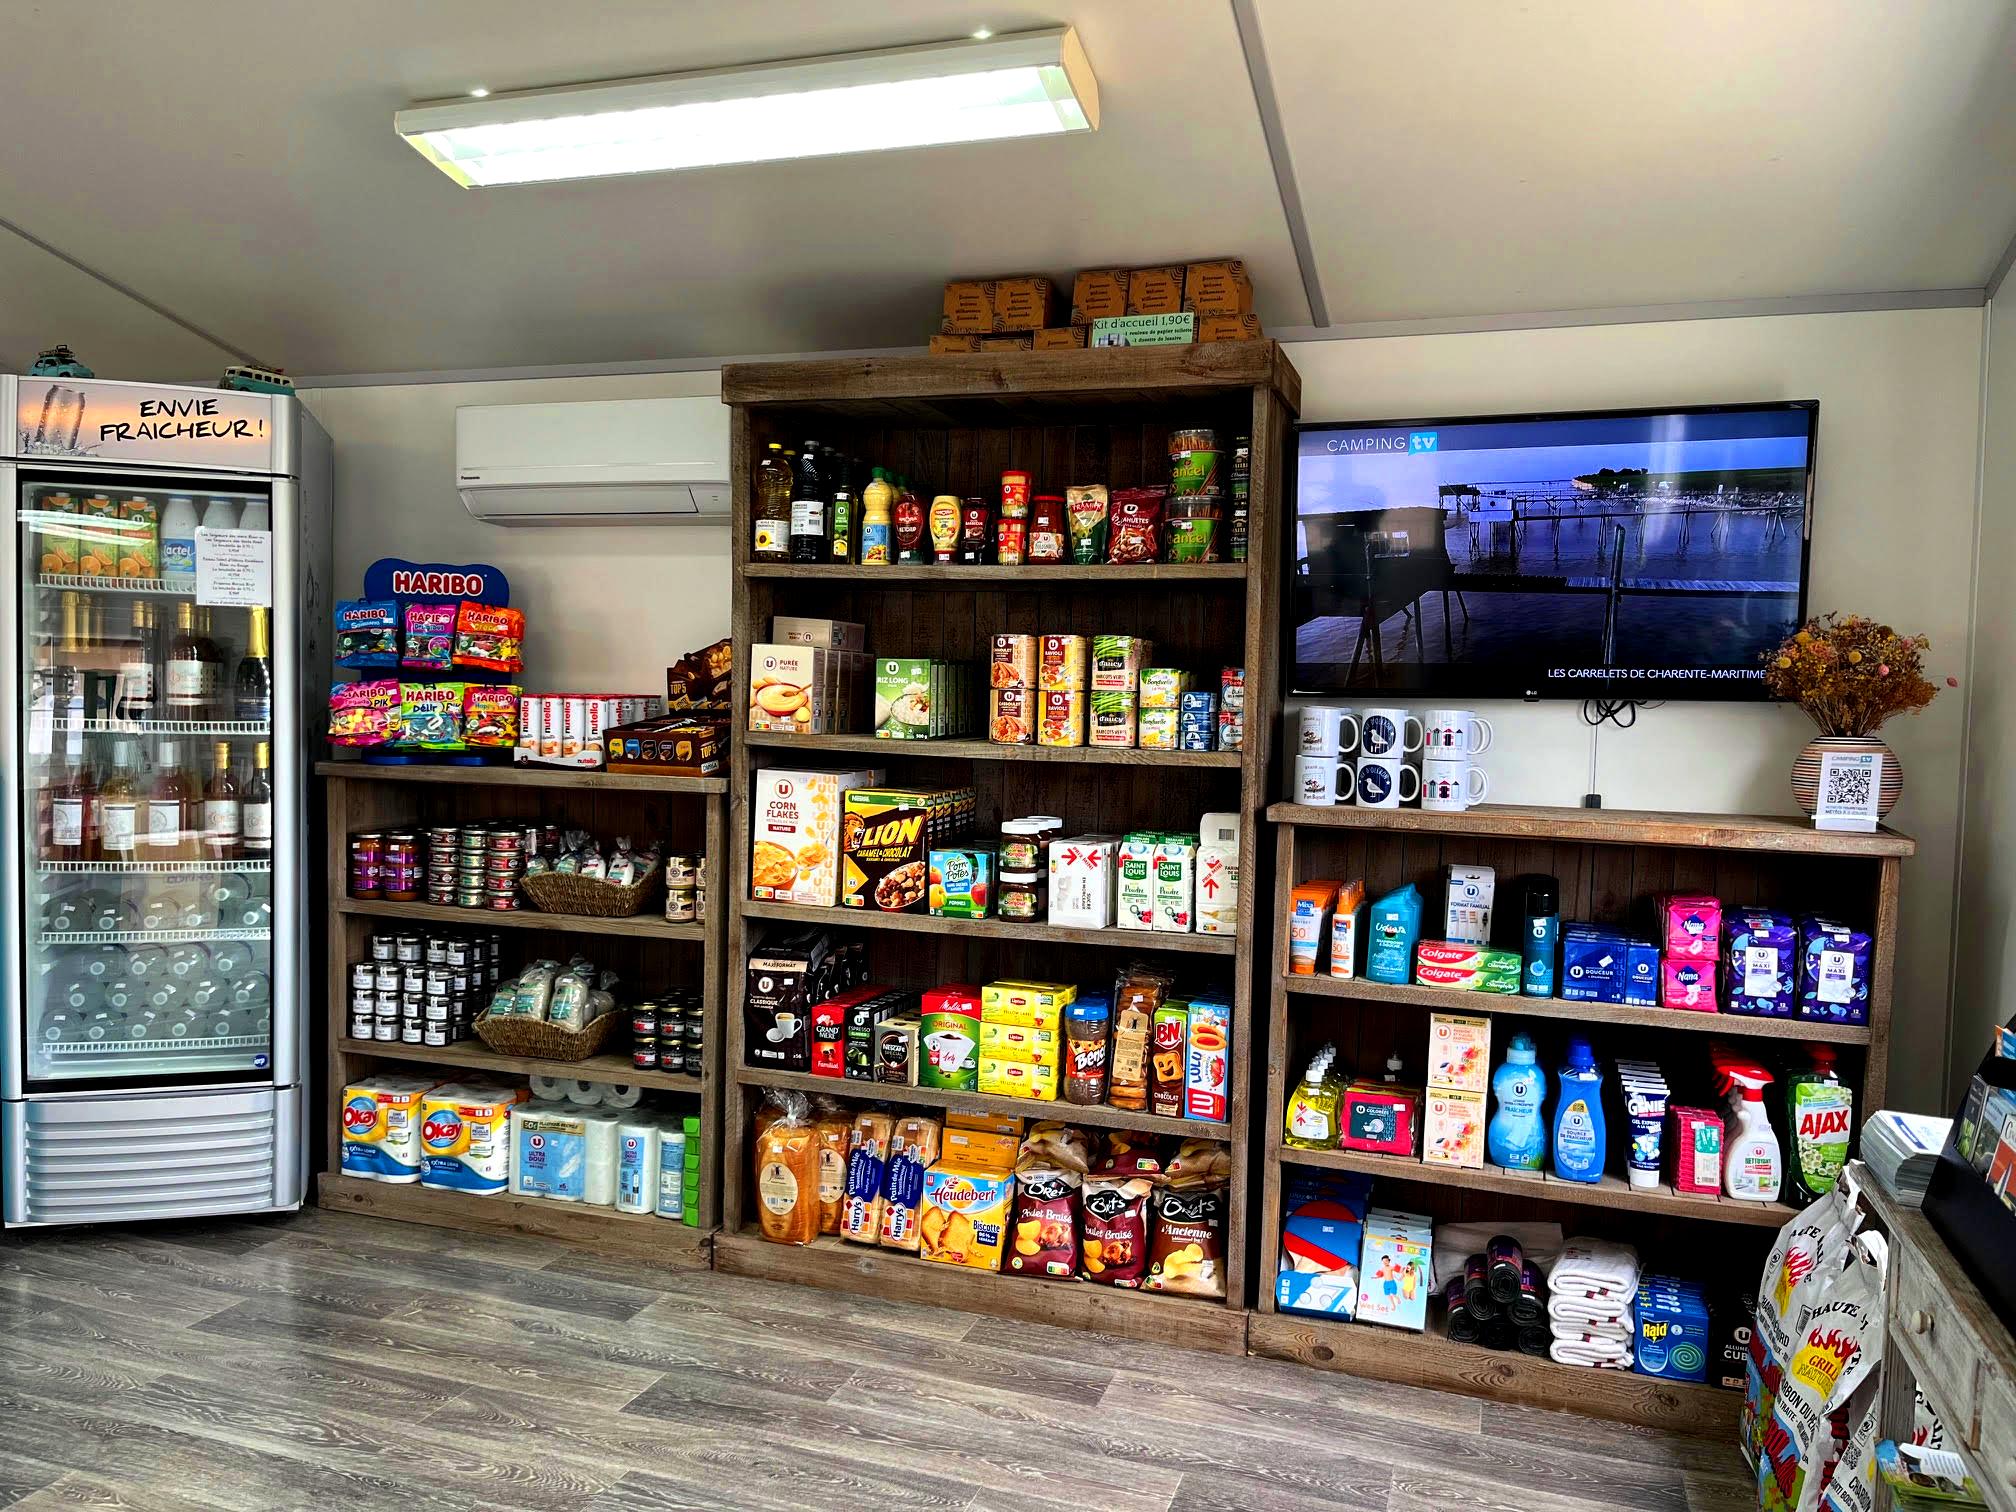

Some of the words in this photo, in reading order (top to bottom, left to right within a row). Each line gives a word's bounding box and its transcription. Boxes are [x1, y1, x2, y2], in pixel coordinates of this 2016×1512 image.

[1094, 321, 1107, 329] Kit
[1111, 317, 1158, 328] d'accueil
[1162, 315, 1190, 326] 1,90€
[140, 399, 219, 417] ENVIE
[1327, 437, 1405, 451] CAMPING
[1413, 436, 1435, 449] tv
[1172, 466, 1205, 479] ancel
[1174, 533, 1207, 544] ancel
[393, 571, 483, 595] HARIBO
[344, 609, 386, 621] HARIBO
[467, 611, 508, 625] HARIBO
[779, 658, 798, 666] PURÉE
[1548, 669, 1565, 678] LES
[1568, 669, 1627, 678] CARRELETS
[1630, 670, 1645, 678] DE
[1647, 670, 1766, 679] CHARENTE-MARITIME
[406, 690, 455, 701] HARIBO
[769, 801, 796, 810] CORN
[766, 810, 799, 819] FLAKES
[861, 815, 925, 848] LION
[857, 849, 880, 857] CARAMEL
[882, 846, 913, 858] CHOCOLAT
[1125, 868, 1145, 876] LOUIS
[1160, 863, 1180, 871] SAINT
[1160, 870, 1180, 878] LOUIS
[1292, 928, 1306, 938] 50
[1333, 944, 1342, 952] 50
[1420, 948, 1463, 960] Colgate
[1420, 967, 1462, 979] Colgate
[1677, 971, 1699, 982] Nana
[933, 1020, 967, 1030] ORIGINAL
[1157, 1022, 1181, 1043] BN
[817, 1061, 839, 1069] Familial
[1190, 1052, 1201, 1083] LULU
[1154, 1093, 1178, 1101] CHOCOLAT
[1192, 1094, 1214, 1114] LU
[343, 1107, 379, 1127] Okay
[423, 1120, 462, 1140] Okay
[1800, 1110, 1848, 1139] AJAX
[851, 1152, 860, 1169] Mie
[893, 1158, 902, 1175] Mie
[891, 1176, 898, 1185] de
[890, 1185, 898, 1201] Pain
[930, 1186, 996, 1202] Heudebert
[851, 1201, 863, 1231] Harrys
[1046, 1209, 1072, 1223] Braisé
[893, 1208, 905, 1238] Harrys
[973, 1220, 1000, 1233] Biscotte
[1105, 1228, 1133, 1239] Braisé
[1811, 1302, 1860, 1320] HAUTE
[1643, 1322, 1668, 1338] Raid
